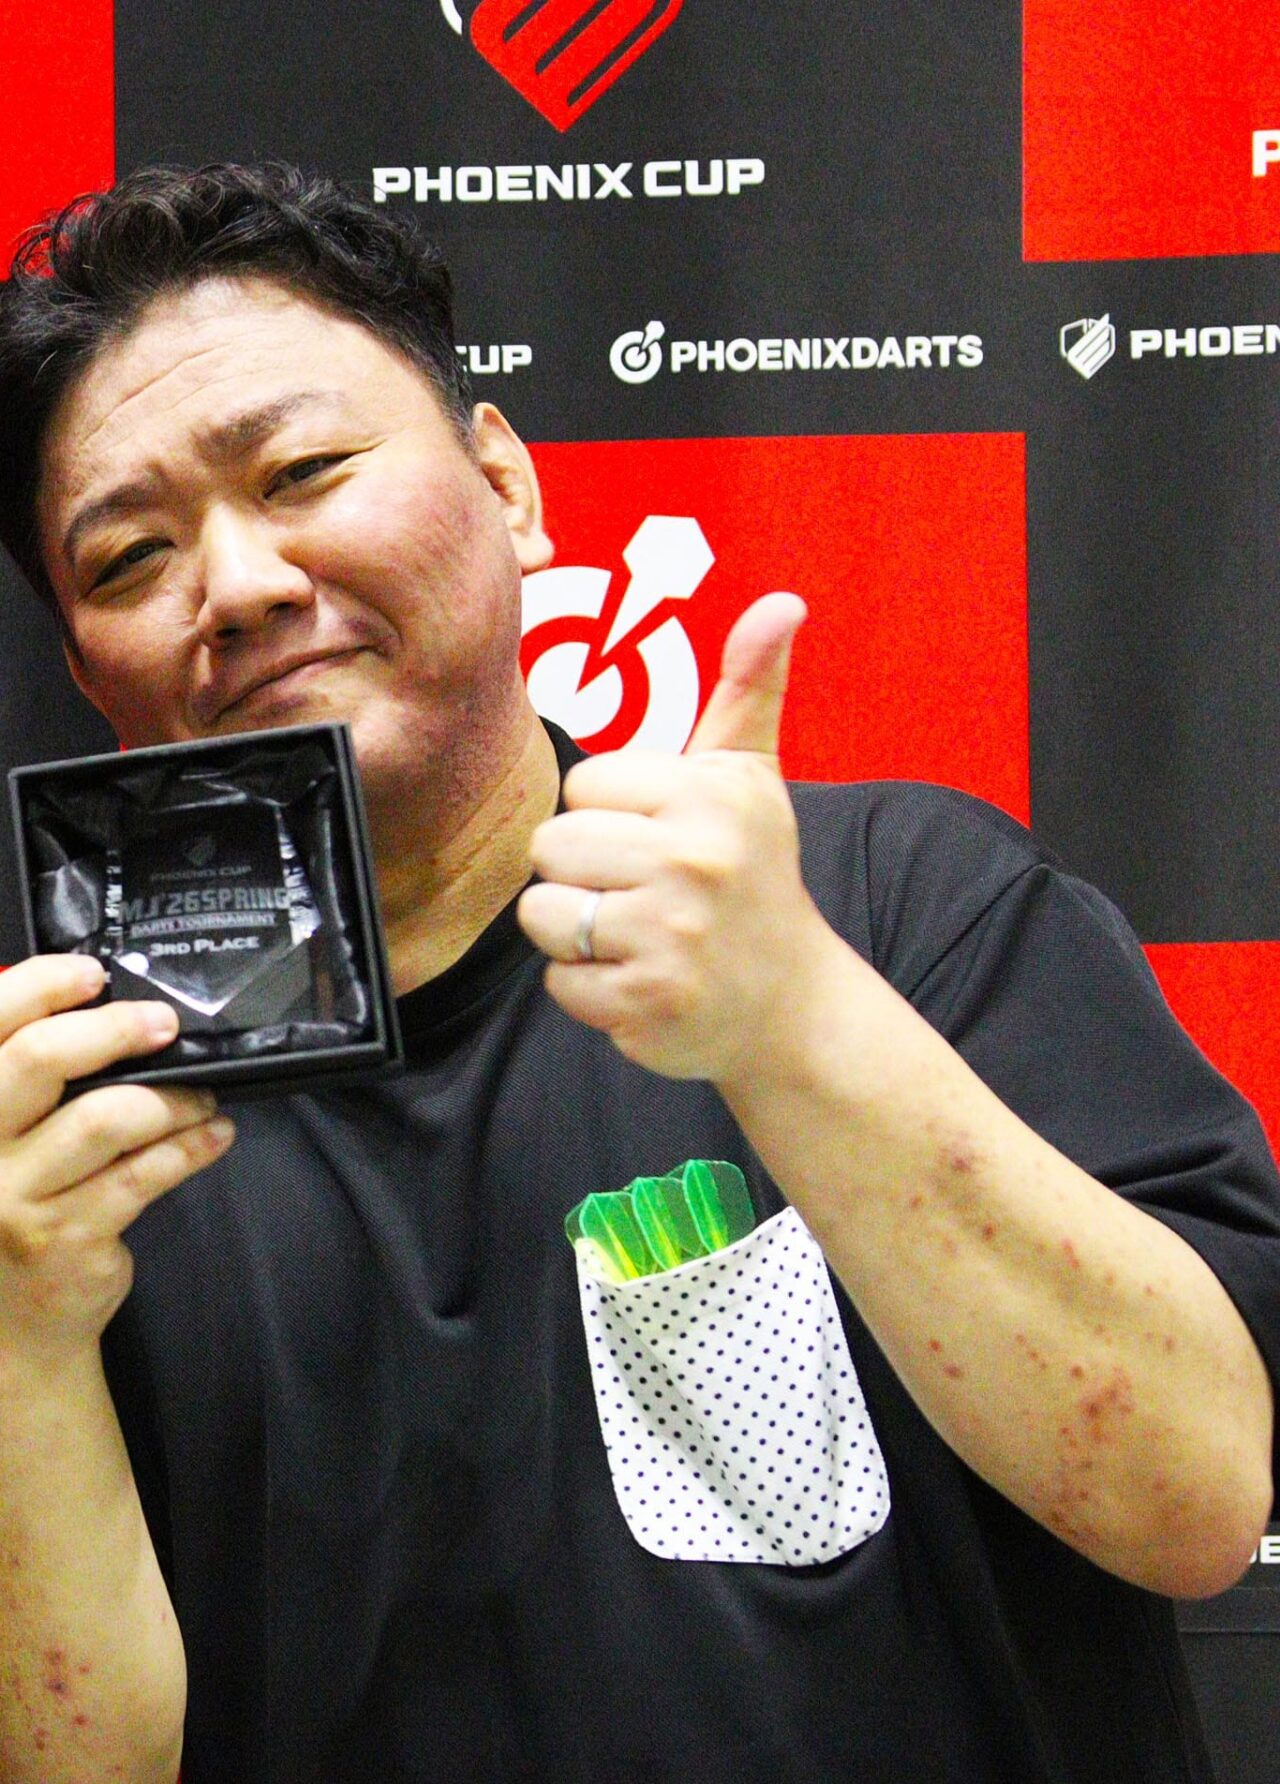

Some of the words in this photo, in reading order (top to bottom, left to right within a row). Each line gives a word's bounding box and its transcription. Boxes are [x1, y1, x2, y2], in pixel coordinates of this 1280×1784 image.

[372, 162, 633, 203] PHOENIX
[643, 158, 765, 196] CUP
[671, 334, 984, 372] PHOENIXDARTS
[193, 935, 260, 953] PLACE
